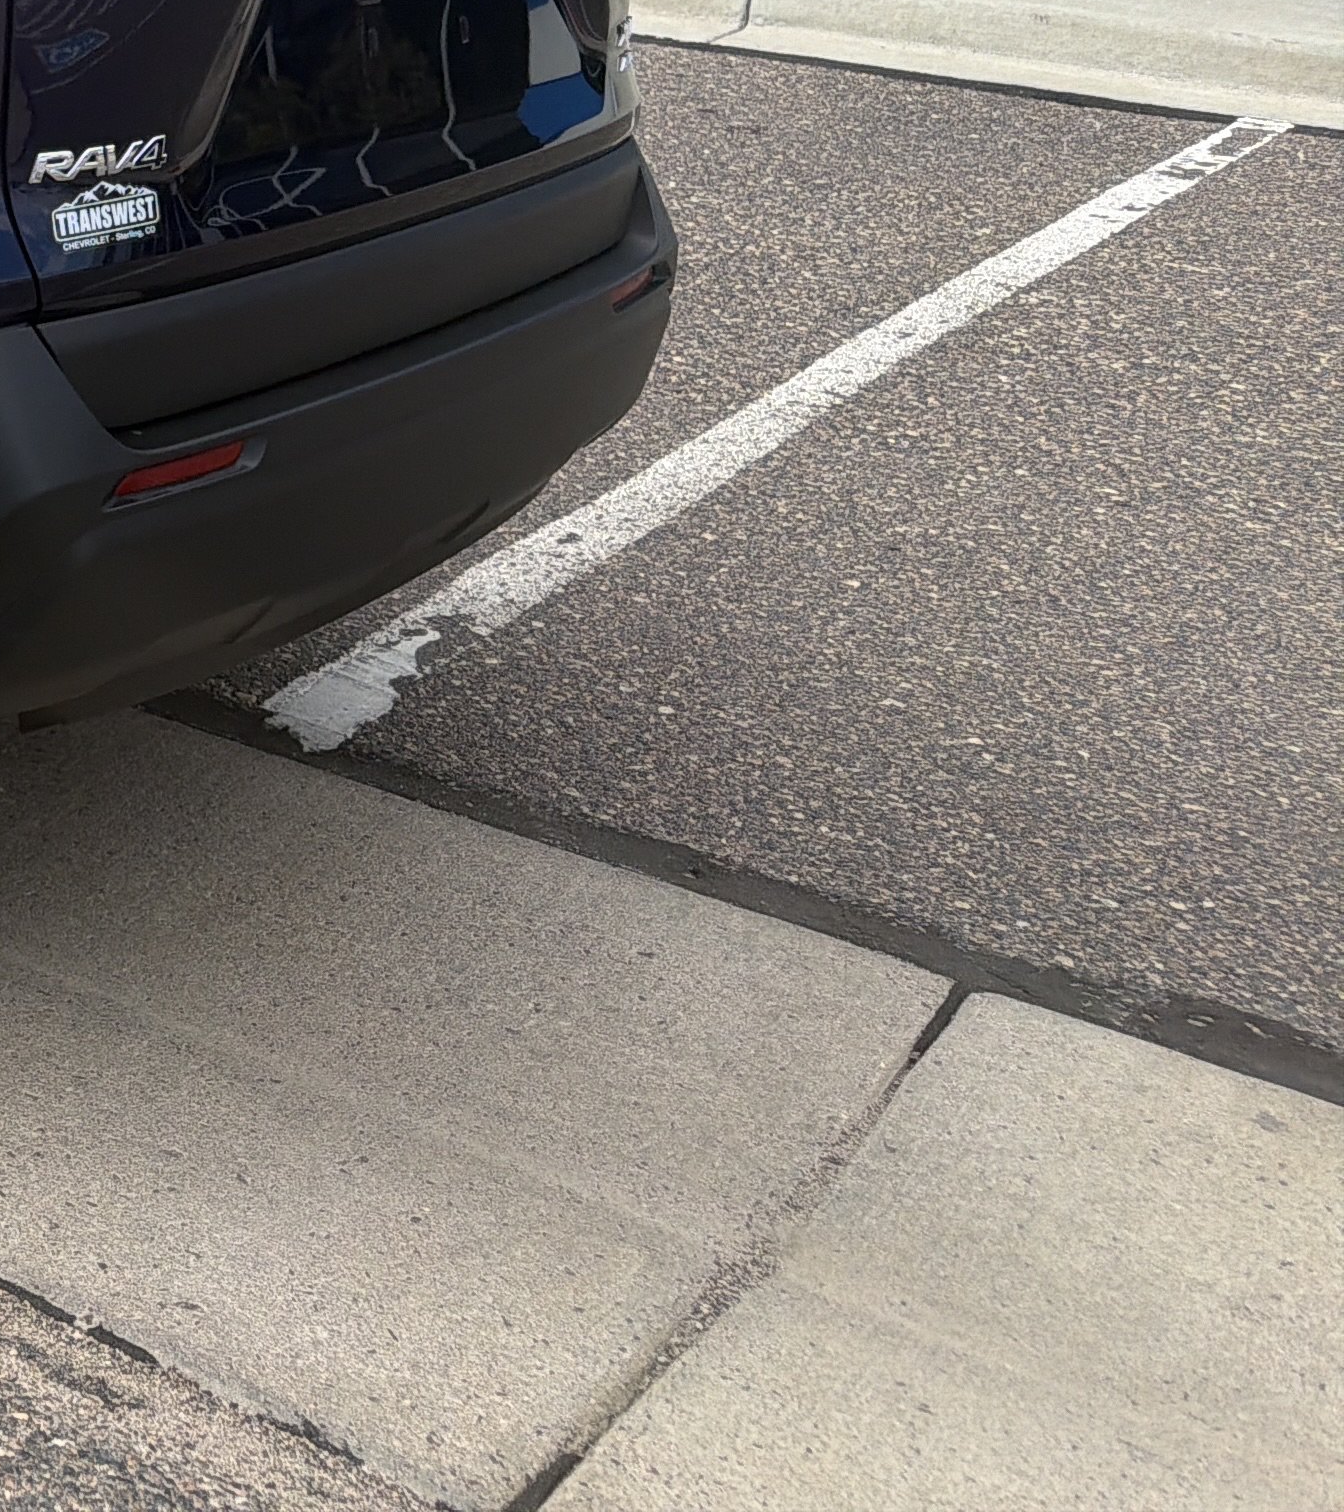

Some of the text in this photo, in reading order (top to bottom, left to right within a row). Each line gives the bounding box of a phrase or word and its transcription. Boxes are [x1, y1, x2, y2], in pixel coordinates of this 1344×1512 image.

[28, 134, 168, 184] RAV4
[55, 195, 154, 237] TRANSWEST
[62, 235, 111, 251] CHEVROLET
